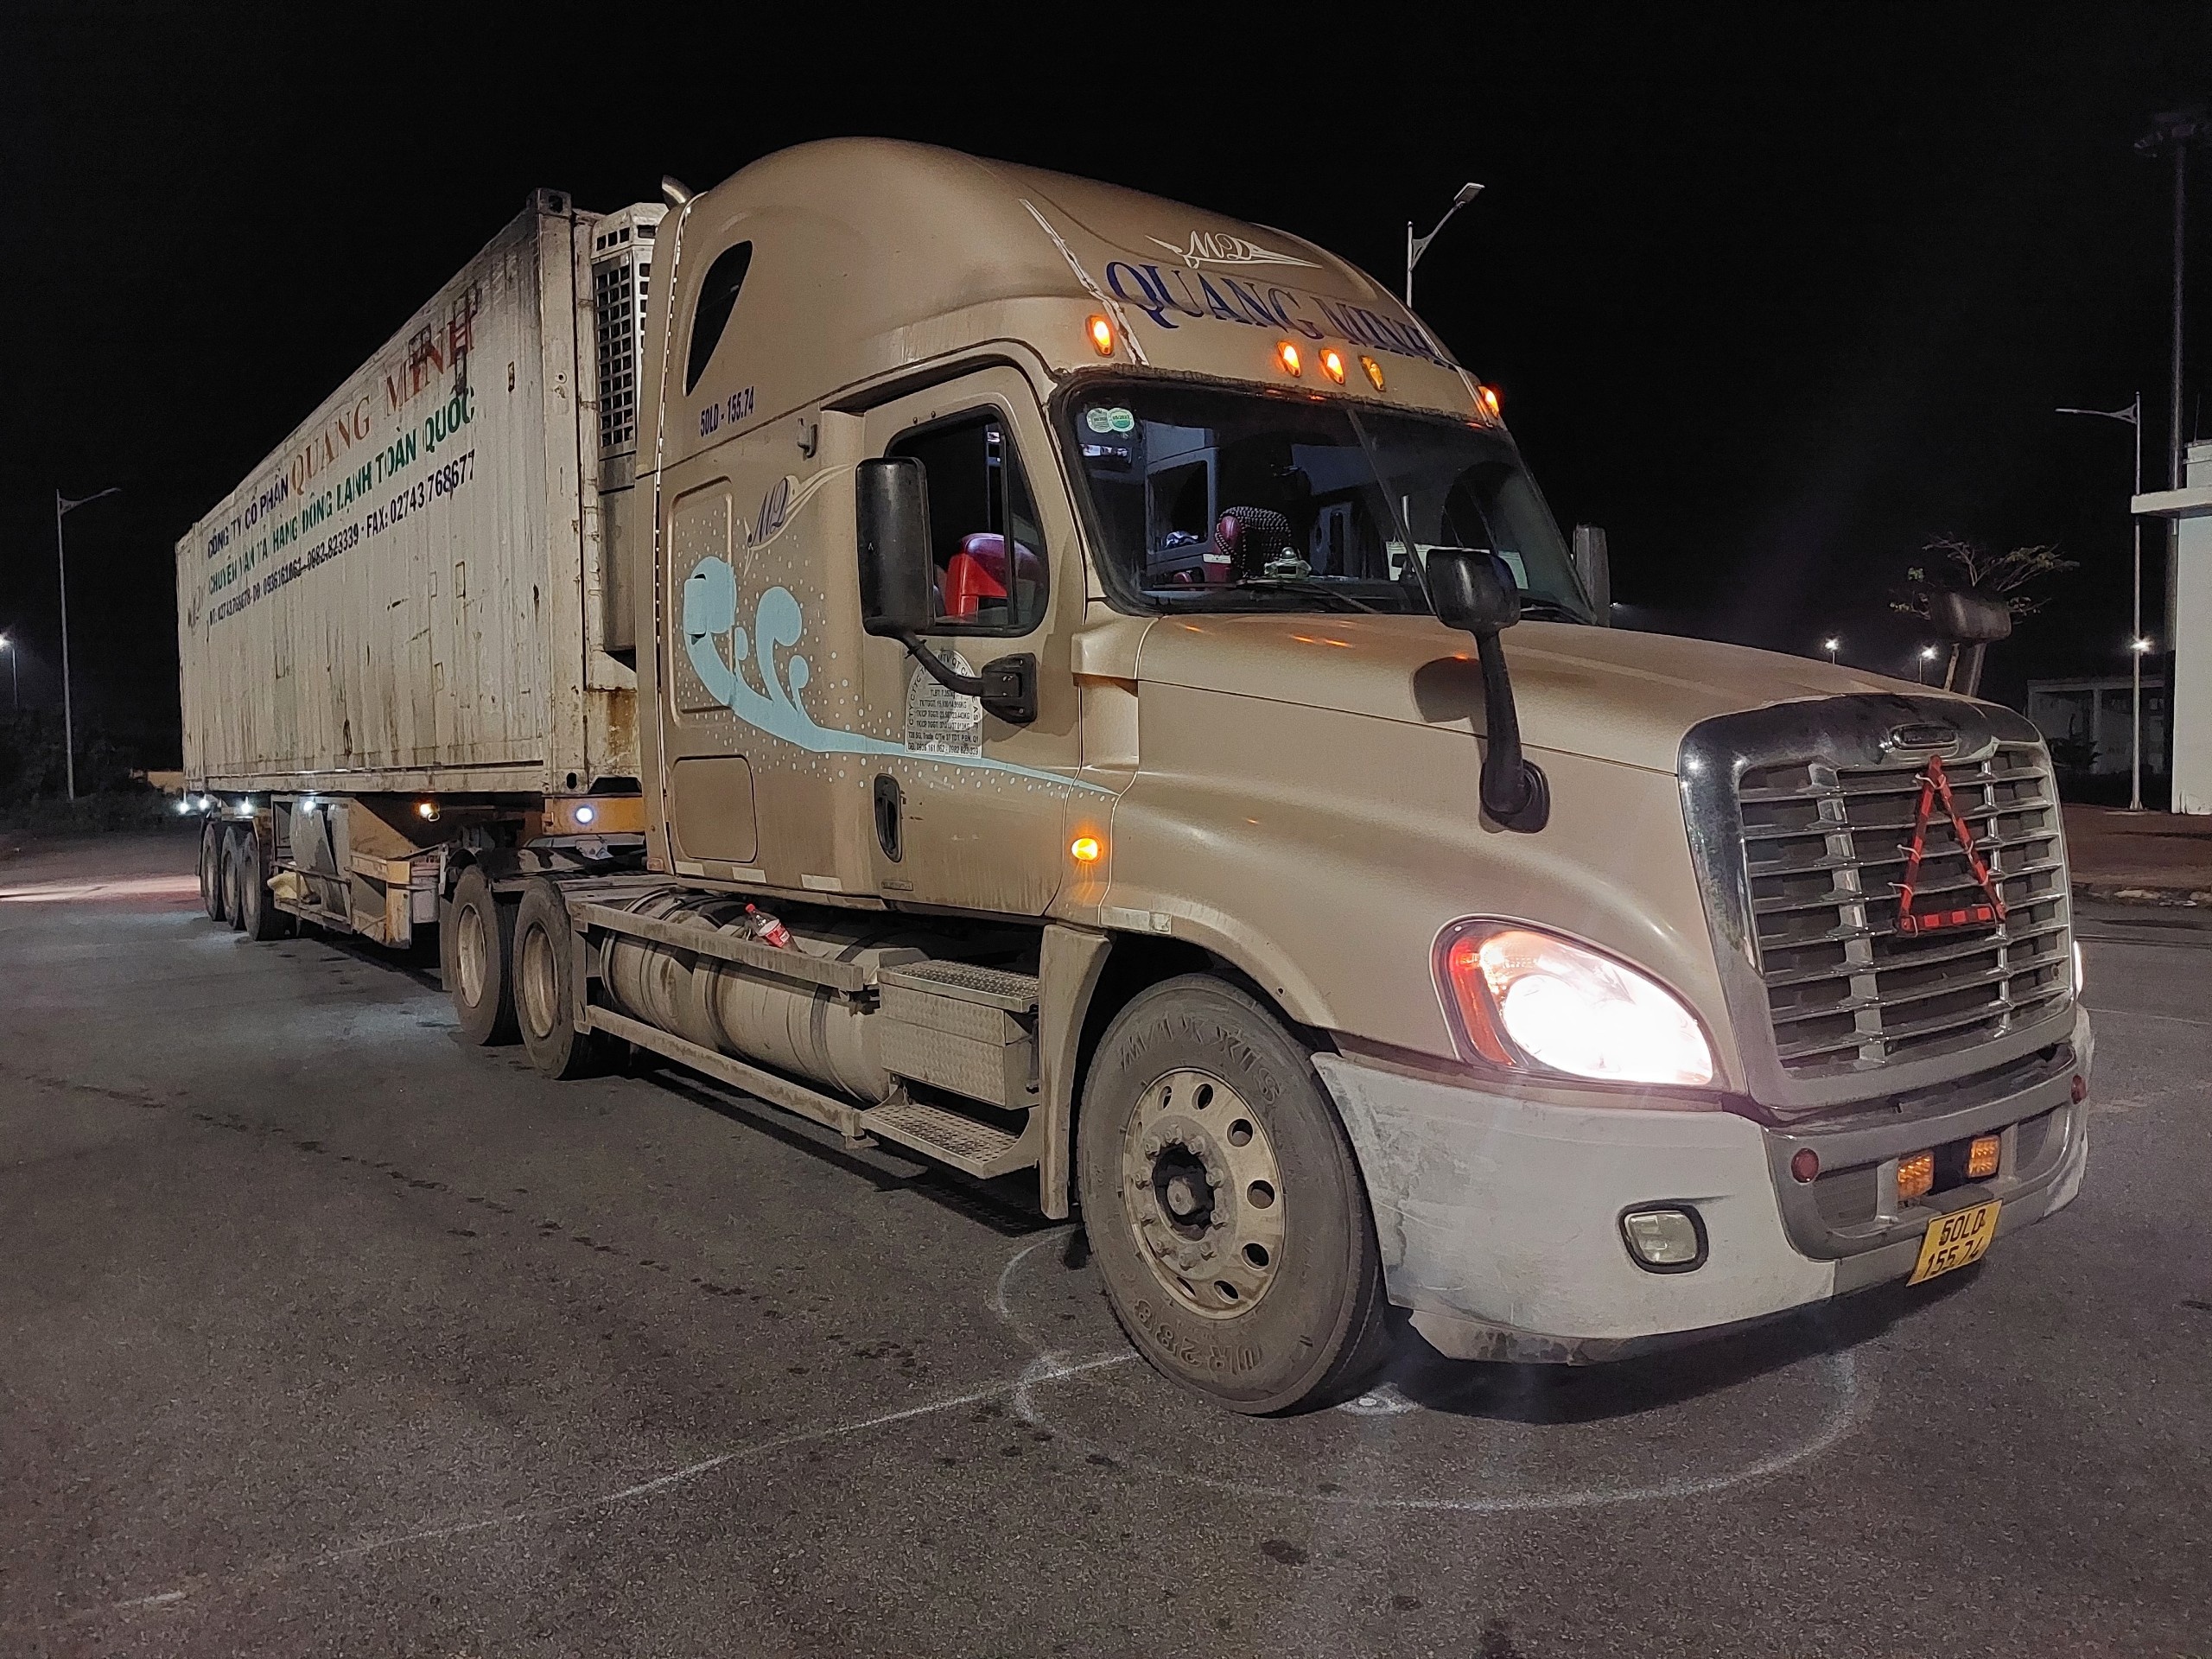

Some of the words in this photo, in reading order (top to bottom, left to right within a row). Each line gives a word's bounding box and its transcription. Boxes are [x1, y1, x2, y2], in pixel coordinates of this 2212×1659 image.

[1106, 261, 1324, 340] QUANG
[207, 526, 229, 559] CÔNG
[231, 515, 241, 540] TY
[291, 396, 370, 495] QUANG
[385, 304, 474, 417] MINH
[700, 403, 718, 437] 50LD
[727, 385, 753, 424] 155.74
[336, 461, 372, 513] LẠNH
[375, 426, 416, 483] TOÀN
[366, 505, 388, 538] FAX:
[1938, 1209, 1986, 1246] 50LD
